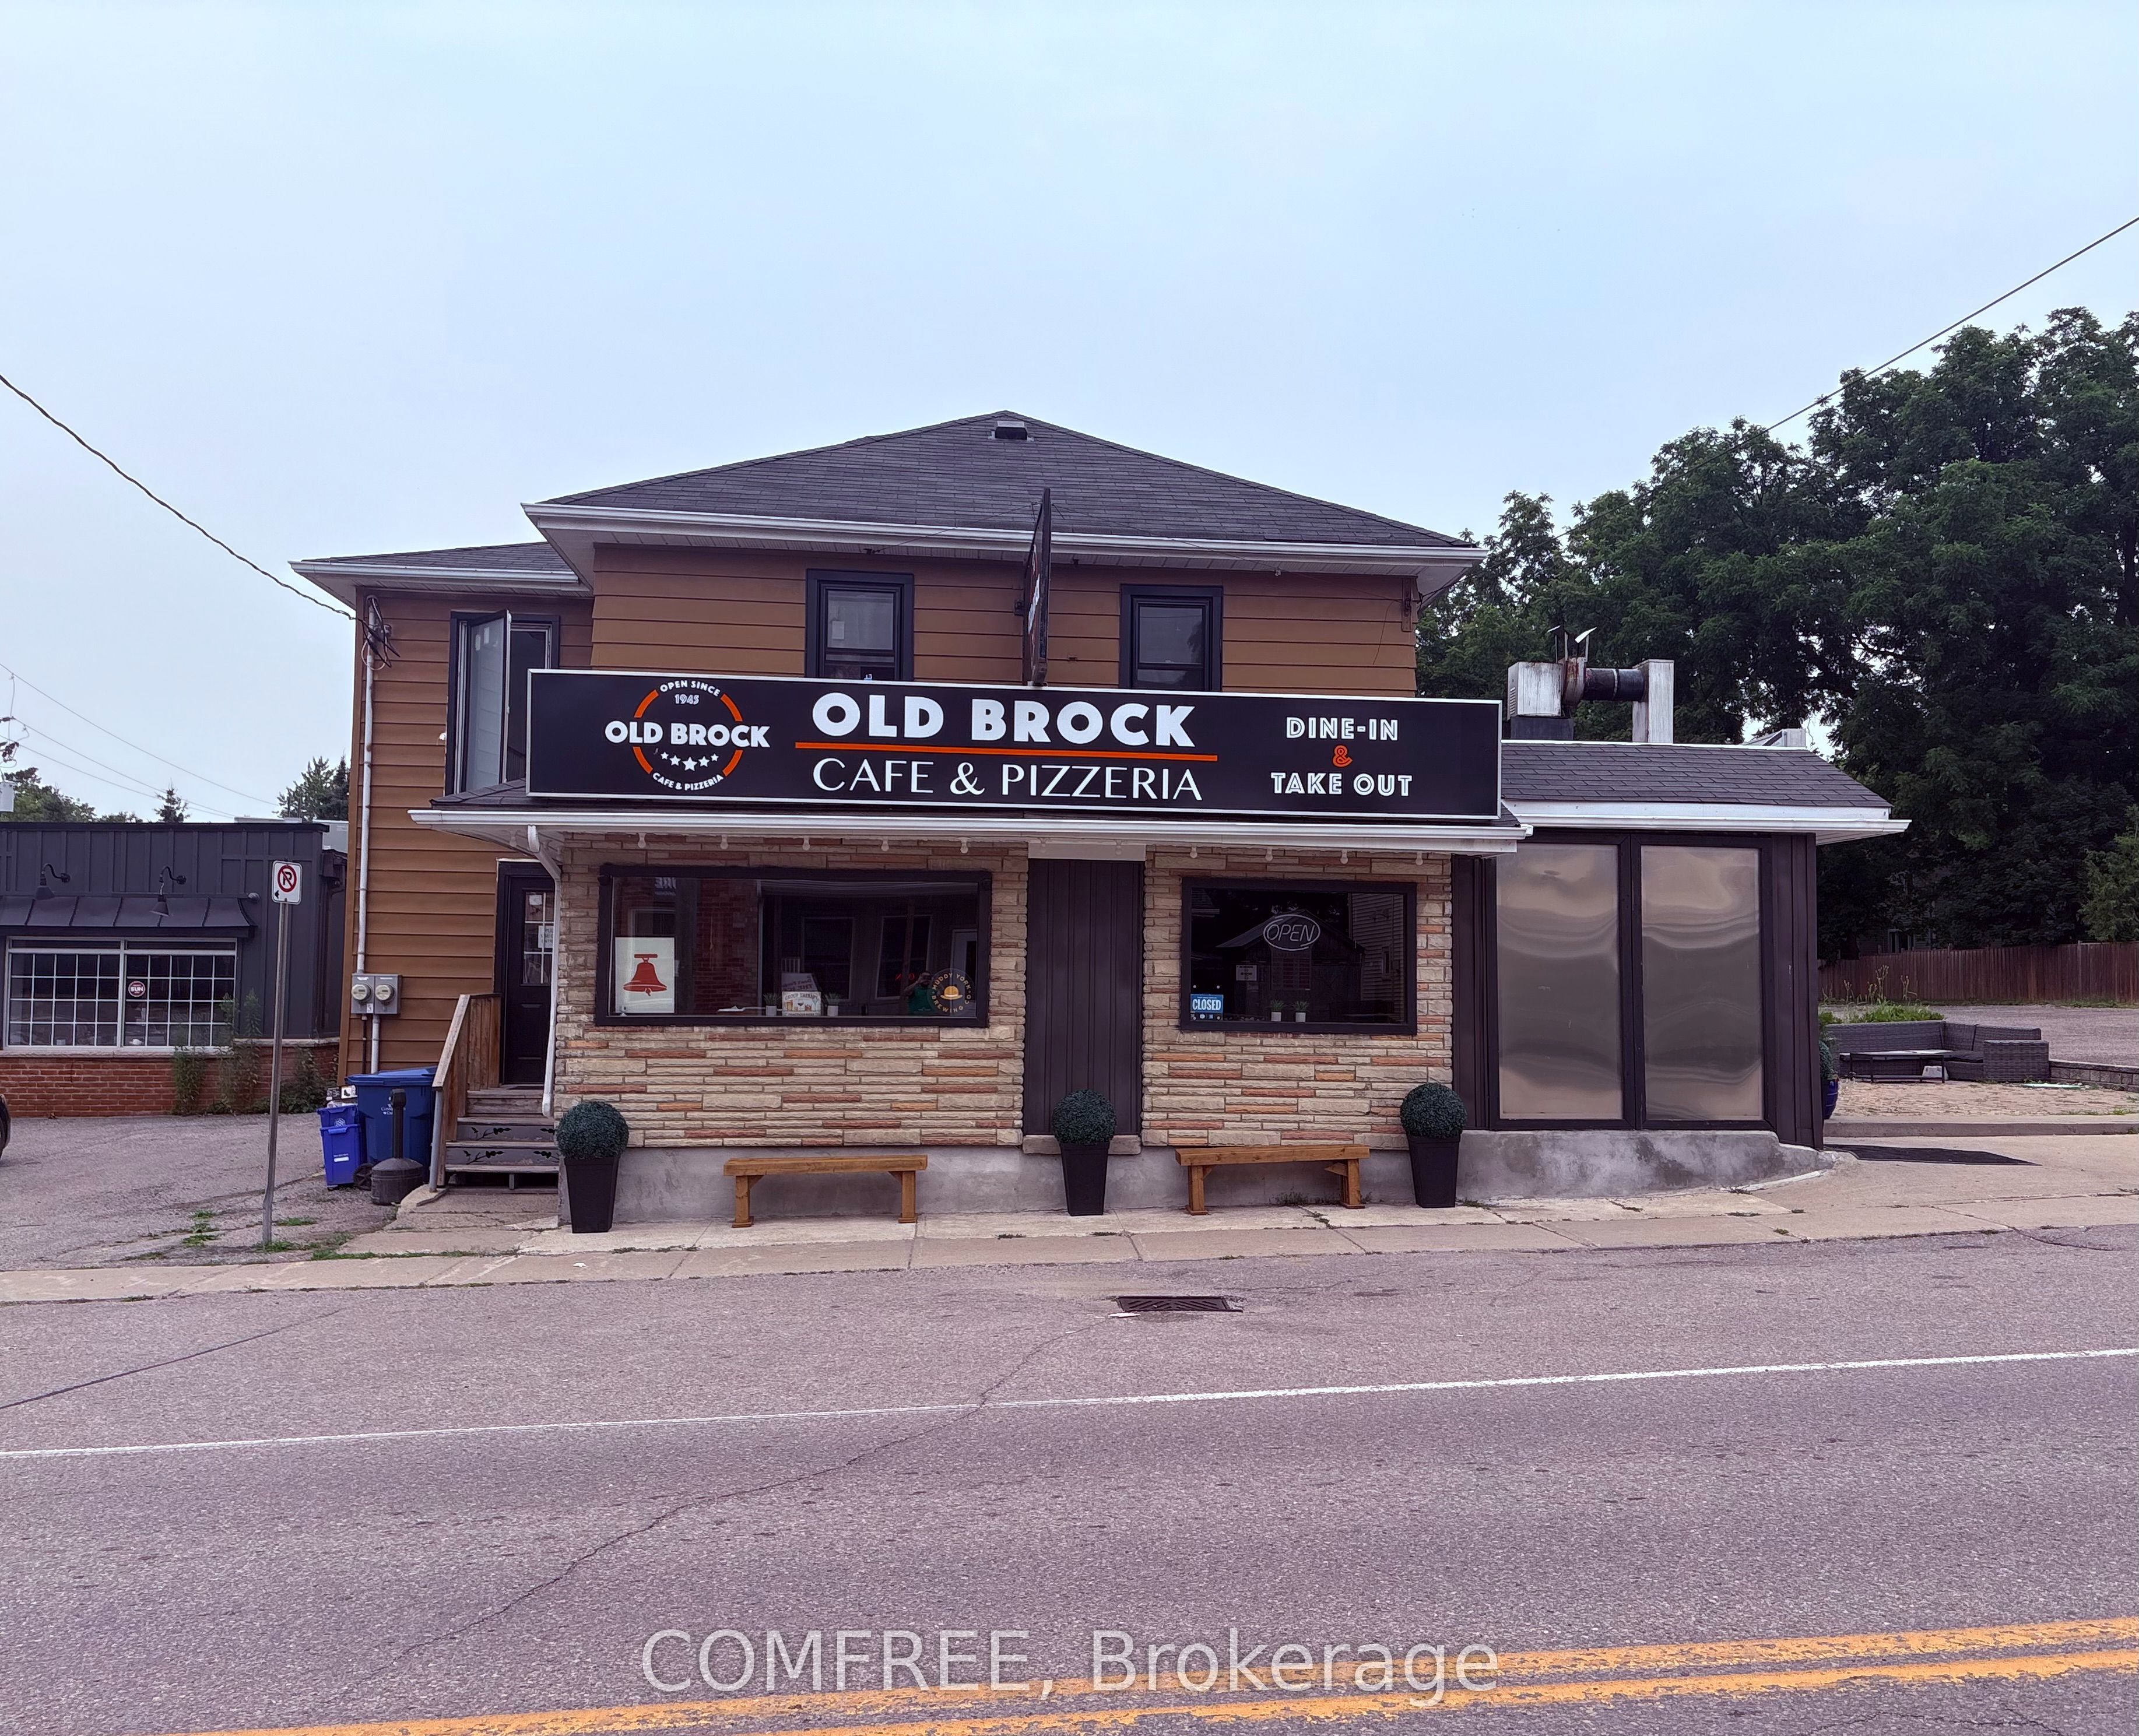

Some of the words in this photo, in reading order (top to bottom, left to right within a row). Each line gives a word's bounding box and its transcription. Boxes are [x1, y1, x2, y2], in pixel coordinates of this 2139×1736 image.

[660, 680, 688, 693] OPEN
[691, 680, 721, 697] SINCE
[675, 694, 700, 705] 1945
[812, 692, 944, 739] OLD
[971, 698, 1196, 747] BROCK
[1286, 716, 1398, 741] DINE-IN
[605, 721, 663, 743] OLD
[670, 722, 770, 747] BROCK
[1332, 744, 1353, 768] &
[652, 772, 674, 788] CAFE
[684, 774, 724, 791] PIZZERIA
[813, 757, 934, 793] CAFE
[950, 762, 985, 795] &
[1002, 763, 1203, 801] PIZZERIA
[1270, 772, 1342, 795] TAKE
[1353, 773, 1413, 797] OUT
[1266, 923, 1315, 942] OPEN
[932, 972, 953, 990] MUDDY
[956, 973, 971, 990] YORK
[931, 994, 964, 1013] BREWING
[1192, 999, 1222, 1011] CLOSED
